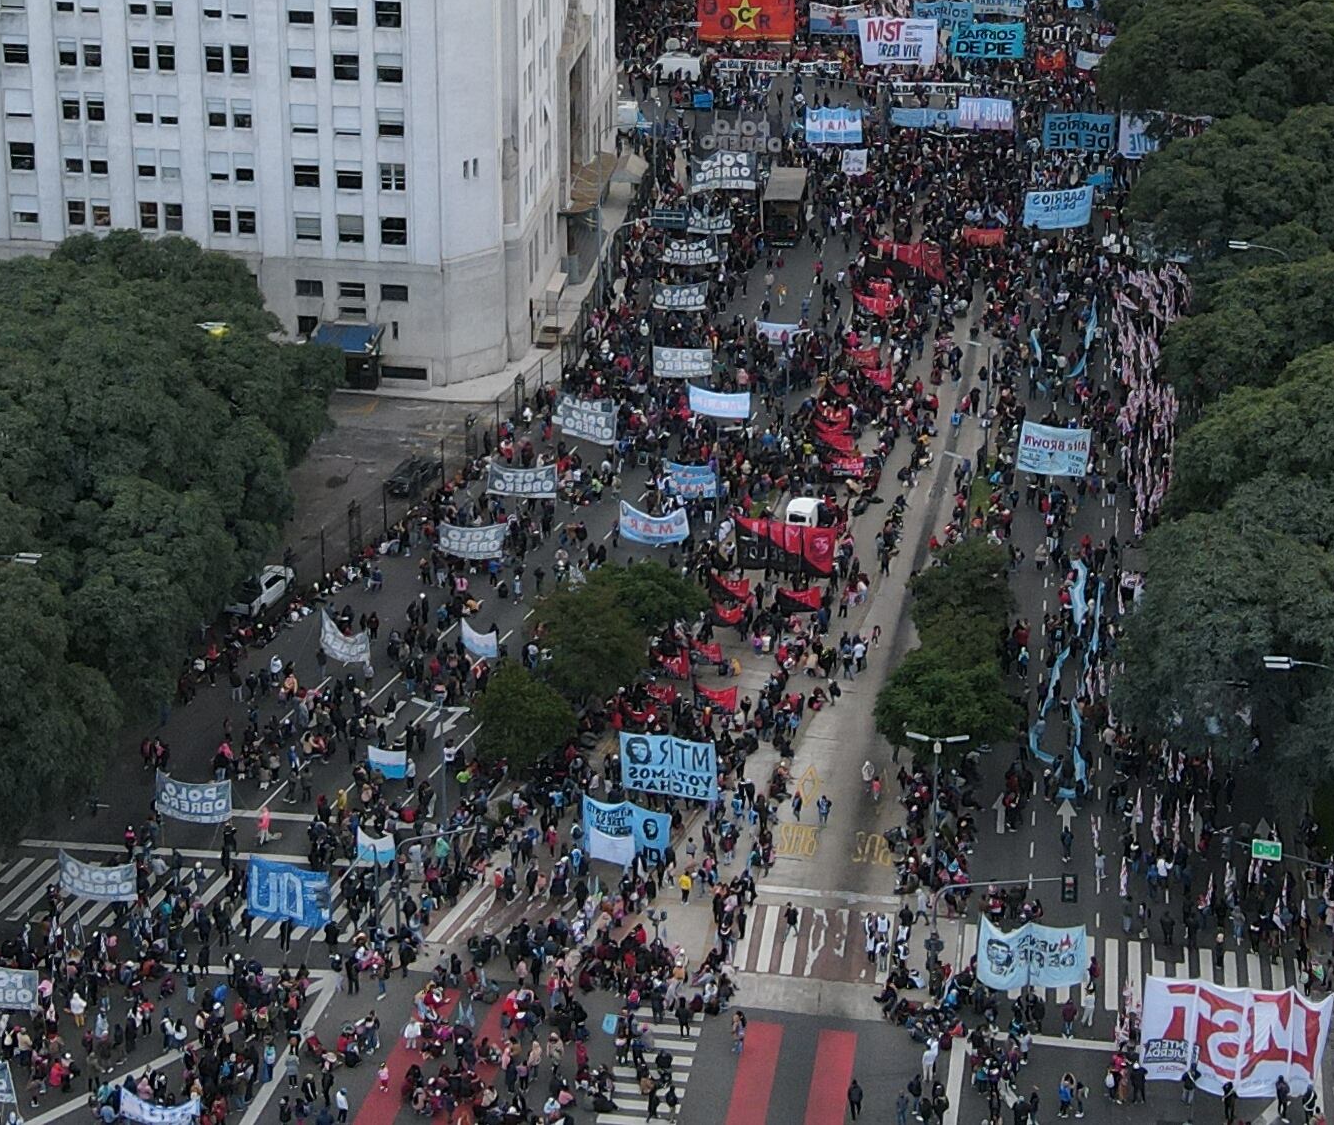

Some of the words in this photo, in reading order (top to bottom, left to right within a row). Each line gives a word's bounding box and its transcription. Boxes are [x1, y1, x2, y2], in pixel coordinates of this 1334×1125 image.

[917, 6, 969, 18] BARRIOS
[867, 19, 906, 43] MST
[958, 29, 1017, 41] BARRIOS
[956, 40, 981, 54] DE
[984, 42, 1013, 56] PIE
